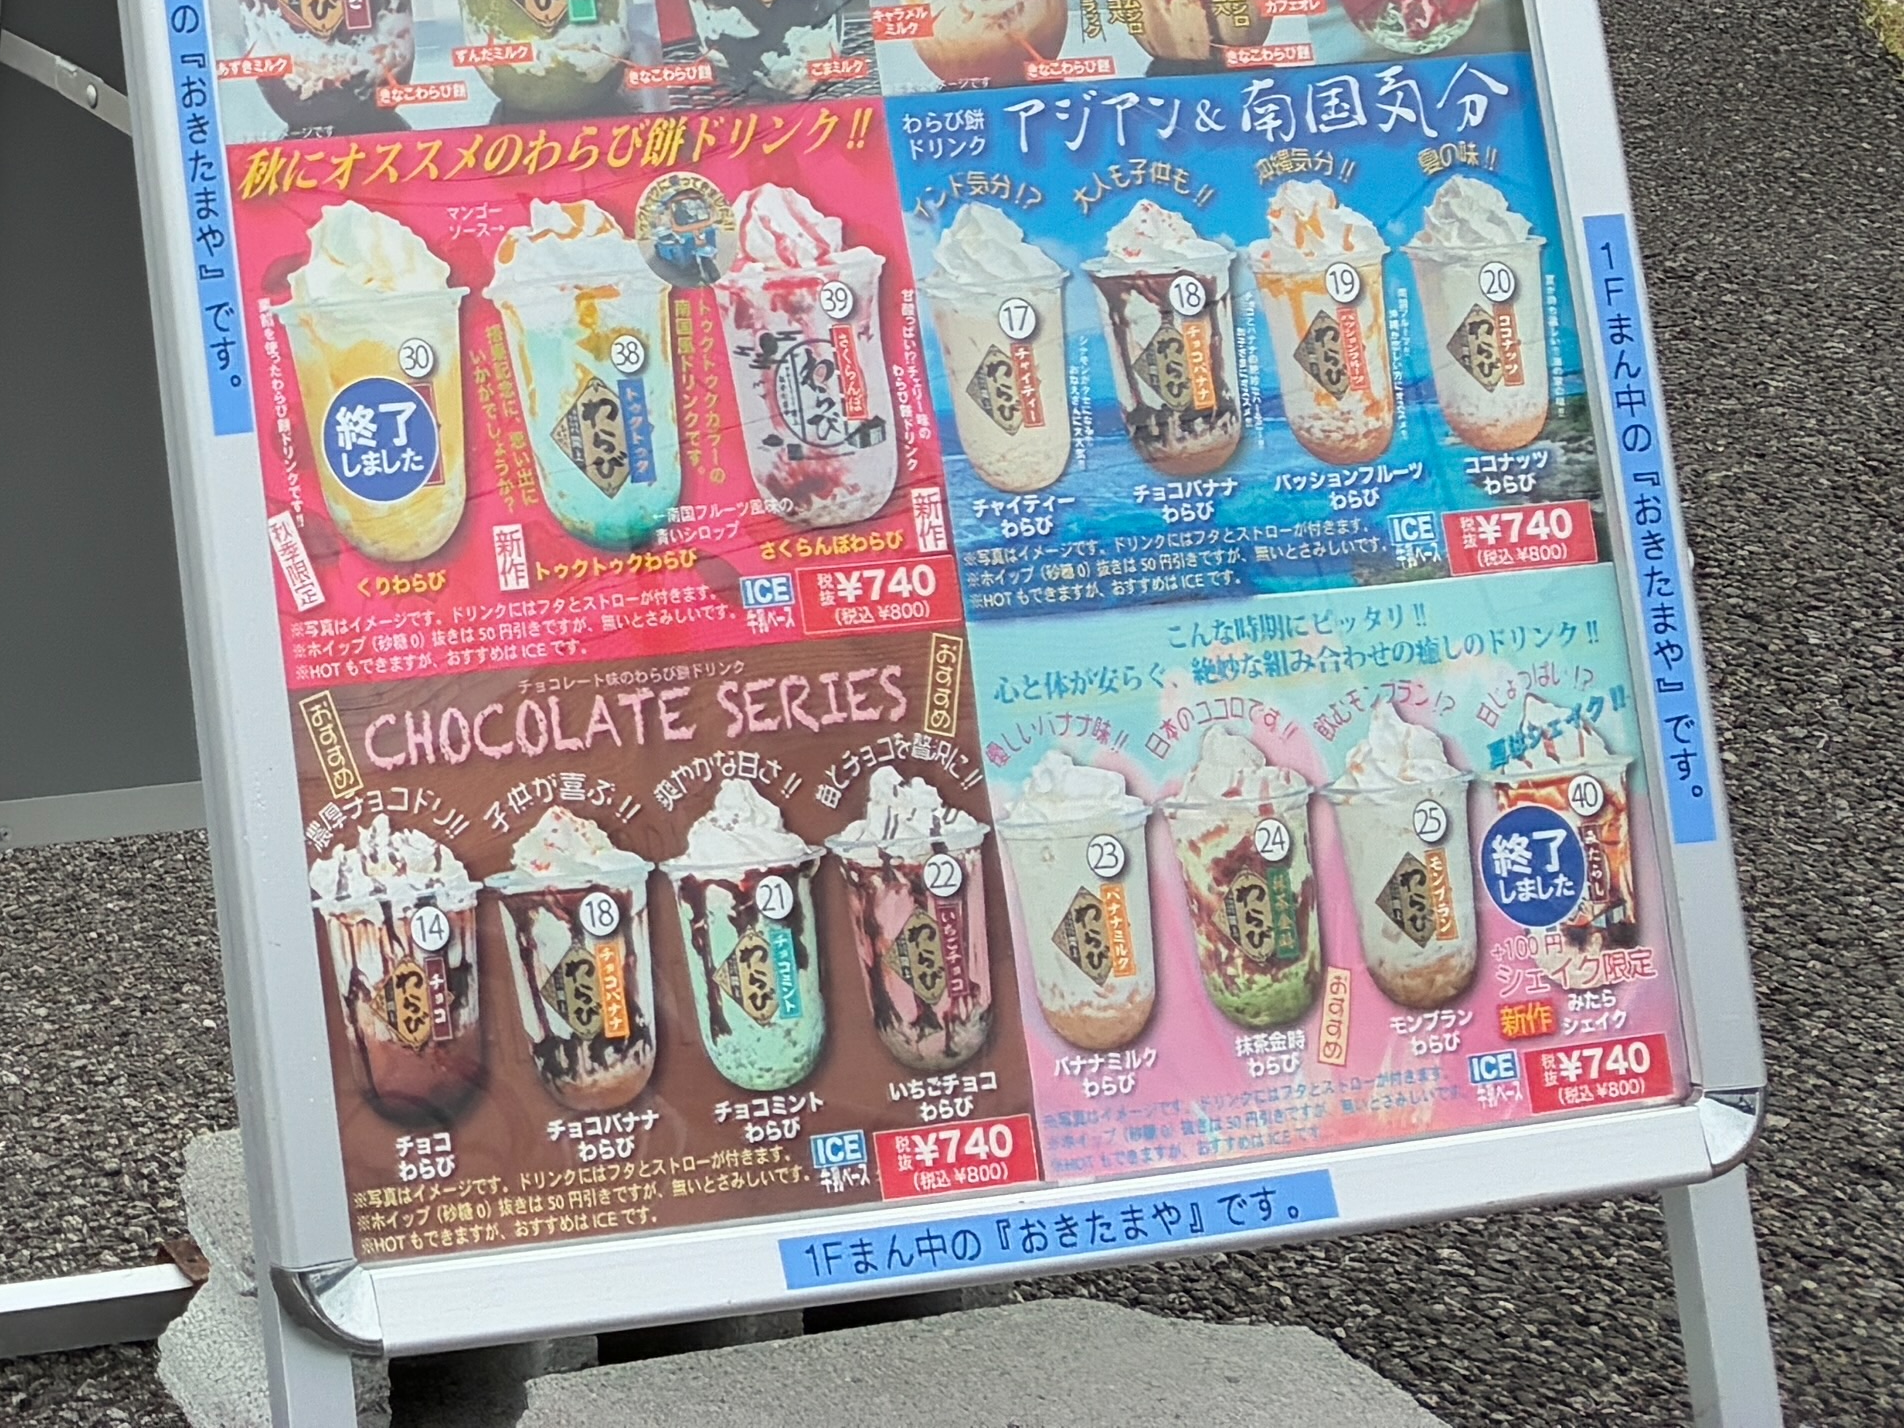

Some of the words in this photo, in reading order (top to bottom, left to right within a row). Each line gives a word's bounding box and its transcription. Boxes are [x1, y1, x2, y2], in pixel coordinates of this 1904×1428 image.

[902, 109, 986, 133] わらび餅
[910, 134, 987, 159] ドリンク
[336, 401, 417, 450] 終了
[343, 448, 425, 477] しました
[1464, 453, 1550, 474] ココナッツ
[1133, 478, 1238, 502] チョコバナナ
[1276, 464, 1423, 492] パッションフルーツ
[973, 495, 1076, 518] チャイティー
[1001, 515, 1053, 538] わらび
[1480, 509, 1573, 544] ¥740
[760, 529, 904, 558] さくらんぼわらび
[495, 529, 527, 588] 新作
[535, 547, 697, 581] トゥクトゥクわらび
[358, 569, 447, 598] くりわらび
[836, 564, 937, 602] ¥740
[365, 684, 697, 771] CHOCOLATE
[717, 665, 907, 739] SERIES
[1493, 829, 1568, 876] 終了
[1501, 874, 1575, 903] しました
[1390, 1006, 1473, 1034] モンブラン
[1501, 1003, 1553, 1035] 新作
[1054, 1048, 1158, 1076] バナナミルク
[1560, 1043, 1650, 1079] ¥740
[890, 1074, 997, 1102] いちごチョコ
[547, 1111, 659, 1142] チョコバナナ
[396, 1133, 451, 1158] チョコ
[916, 1126, 1014, 1164] ¥740
